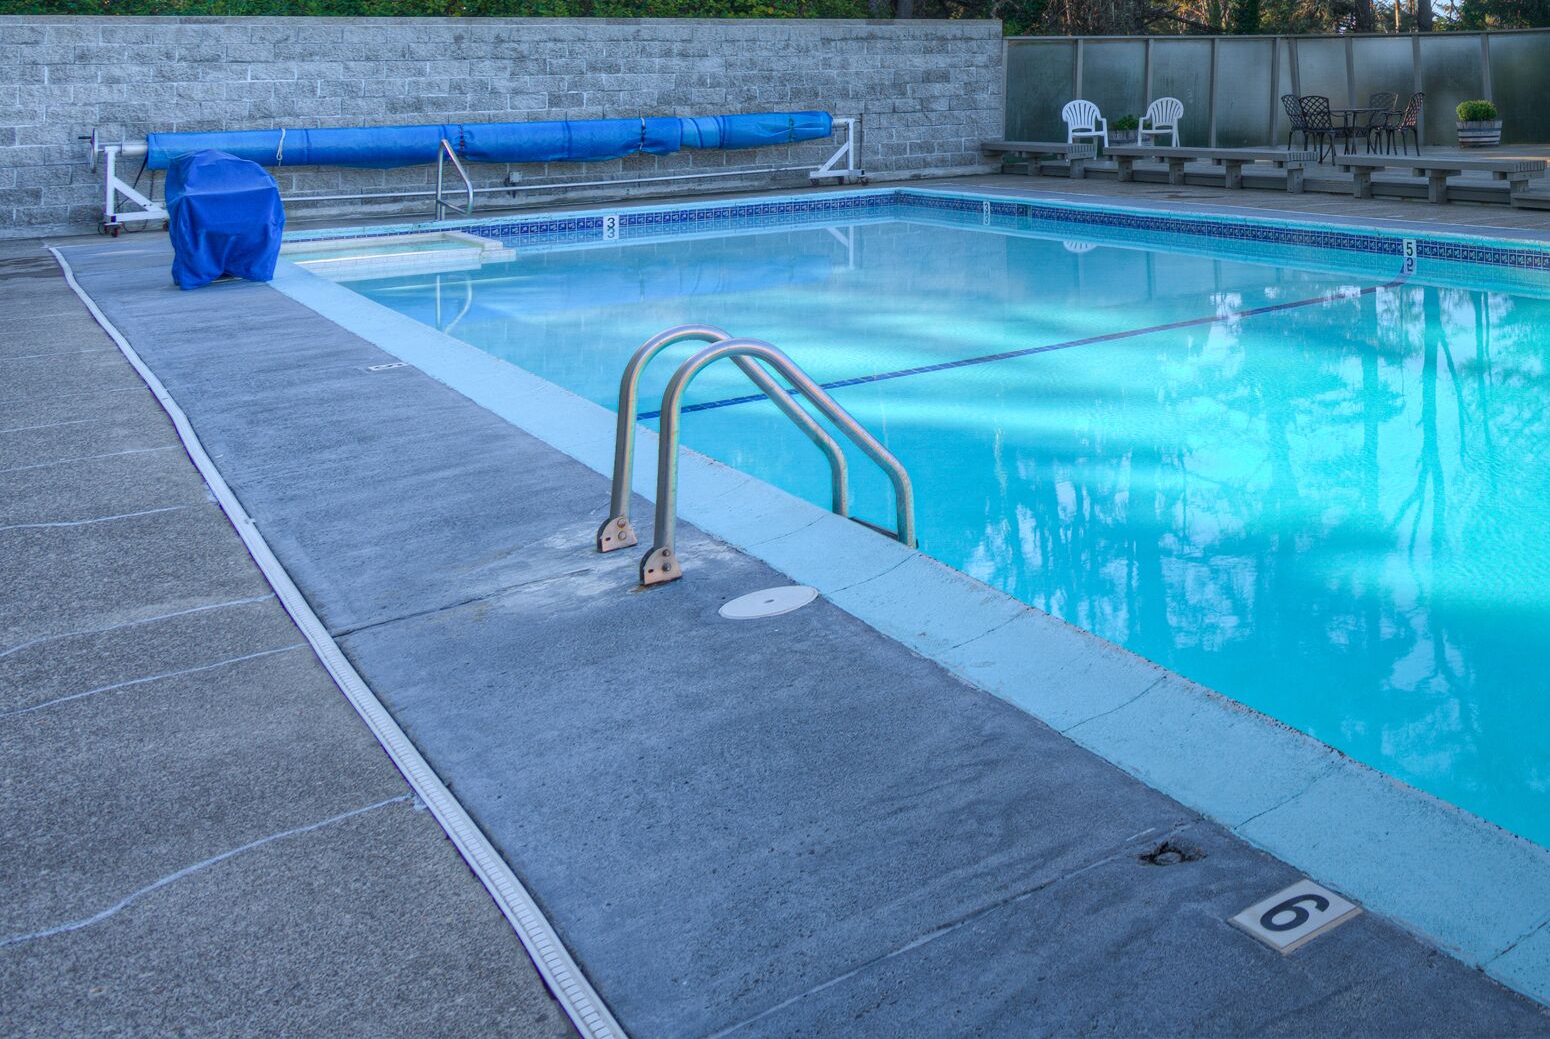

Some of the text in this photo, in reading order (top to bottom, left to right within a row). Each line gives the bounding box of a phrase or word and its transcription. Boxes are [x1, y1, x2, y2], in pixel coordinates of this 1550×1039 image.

[607, 217, 615, 229] 3
[1406, 241, 1413, 256] 5
[1260, 892, 1331, 933] 6
